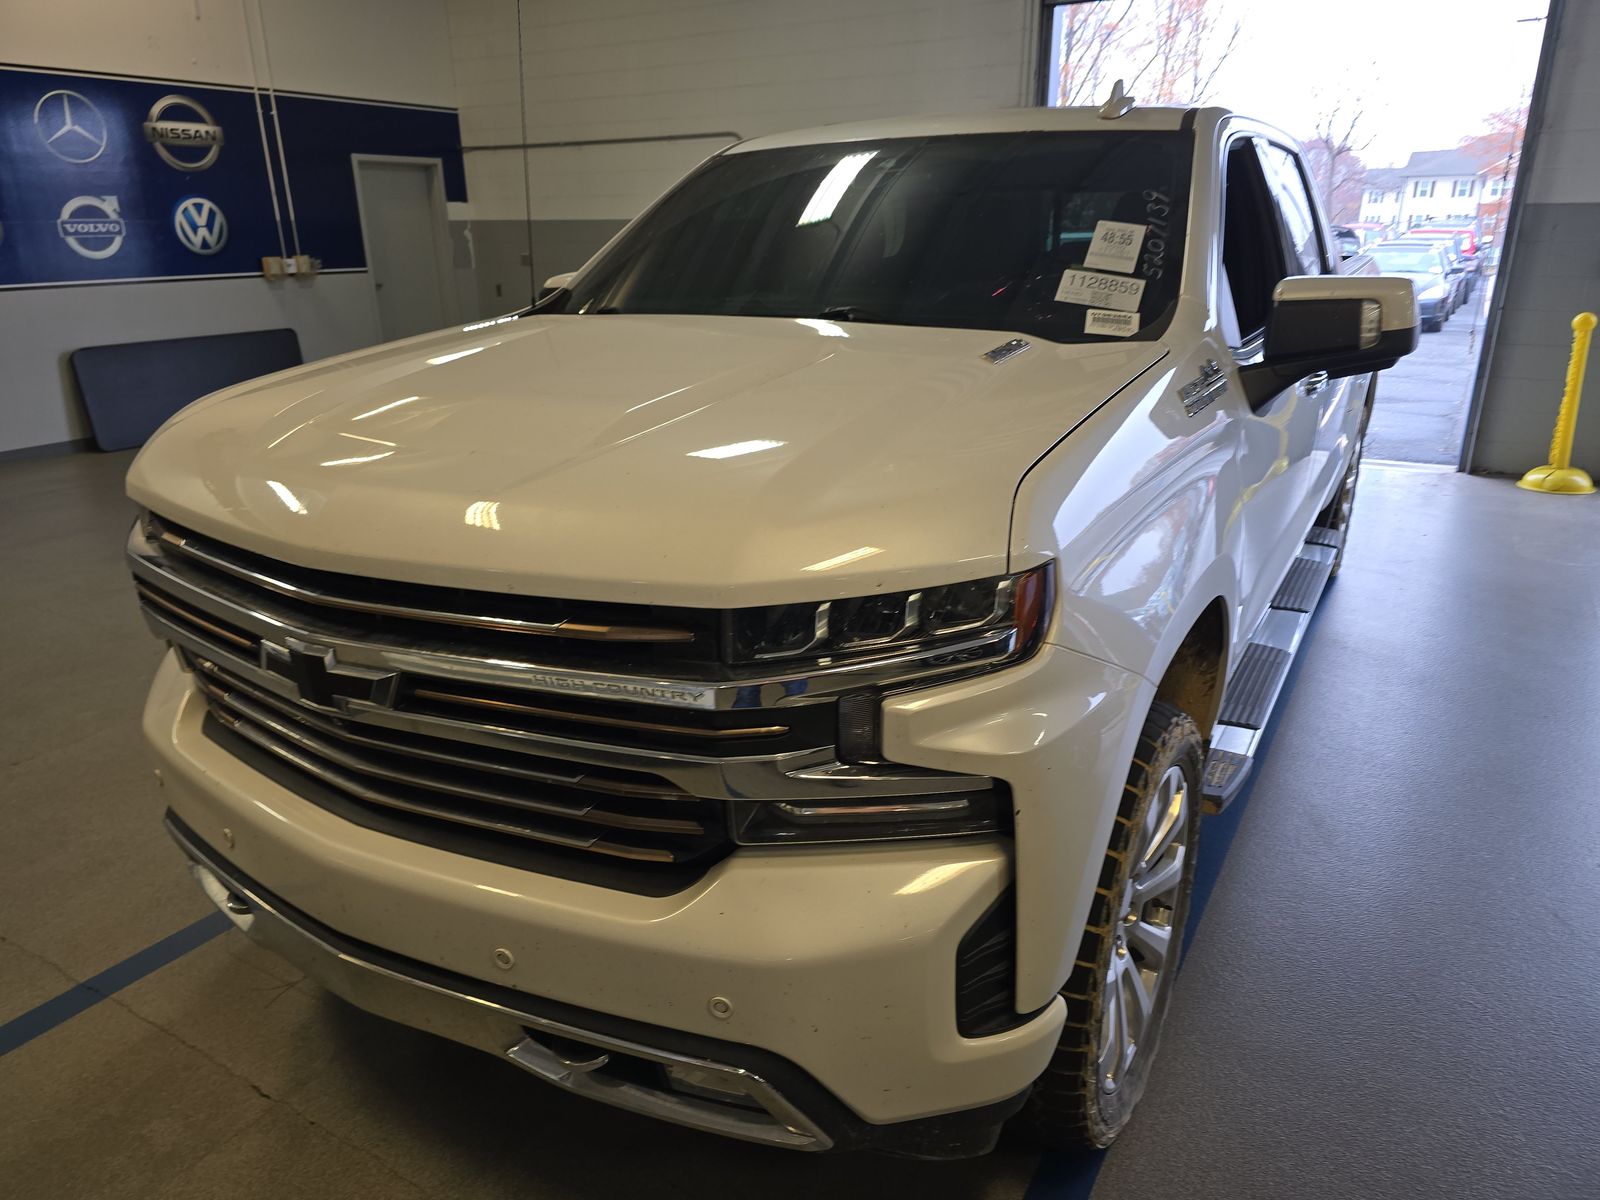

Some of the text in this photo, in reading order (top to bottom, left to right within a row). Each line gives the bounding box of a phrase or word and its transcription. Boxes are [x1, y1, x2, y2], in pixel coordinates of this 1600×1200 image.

[151, 126, 218, 143] NISSAN
[62, 222, 121, 233] VOLVO
[1069, 273, 1141, 297] 1128859
[531, 674, 705, 703] HIGH COUNTRY
